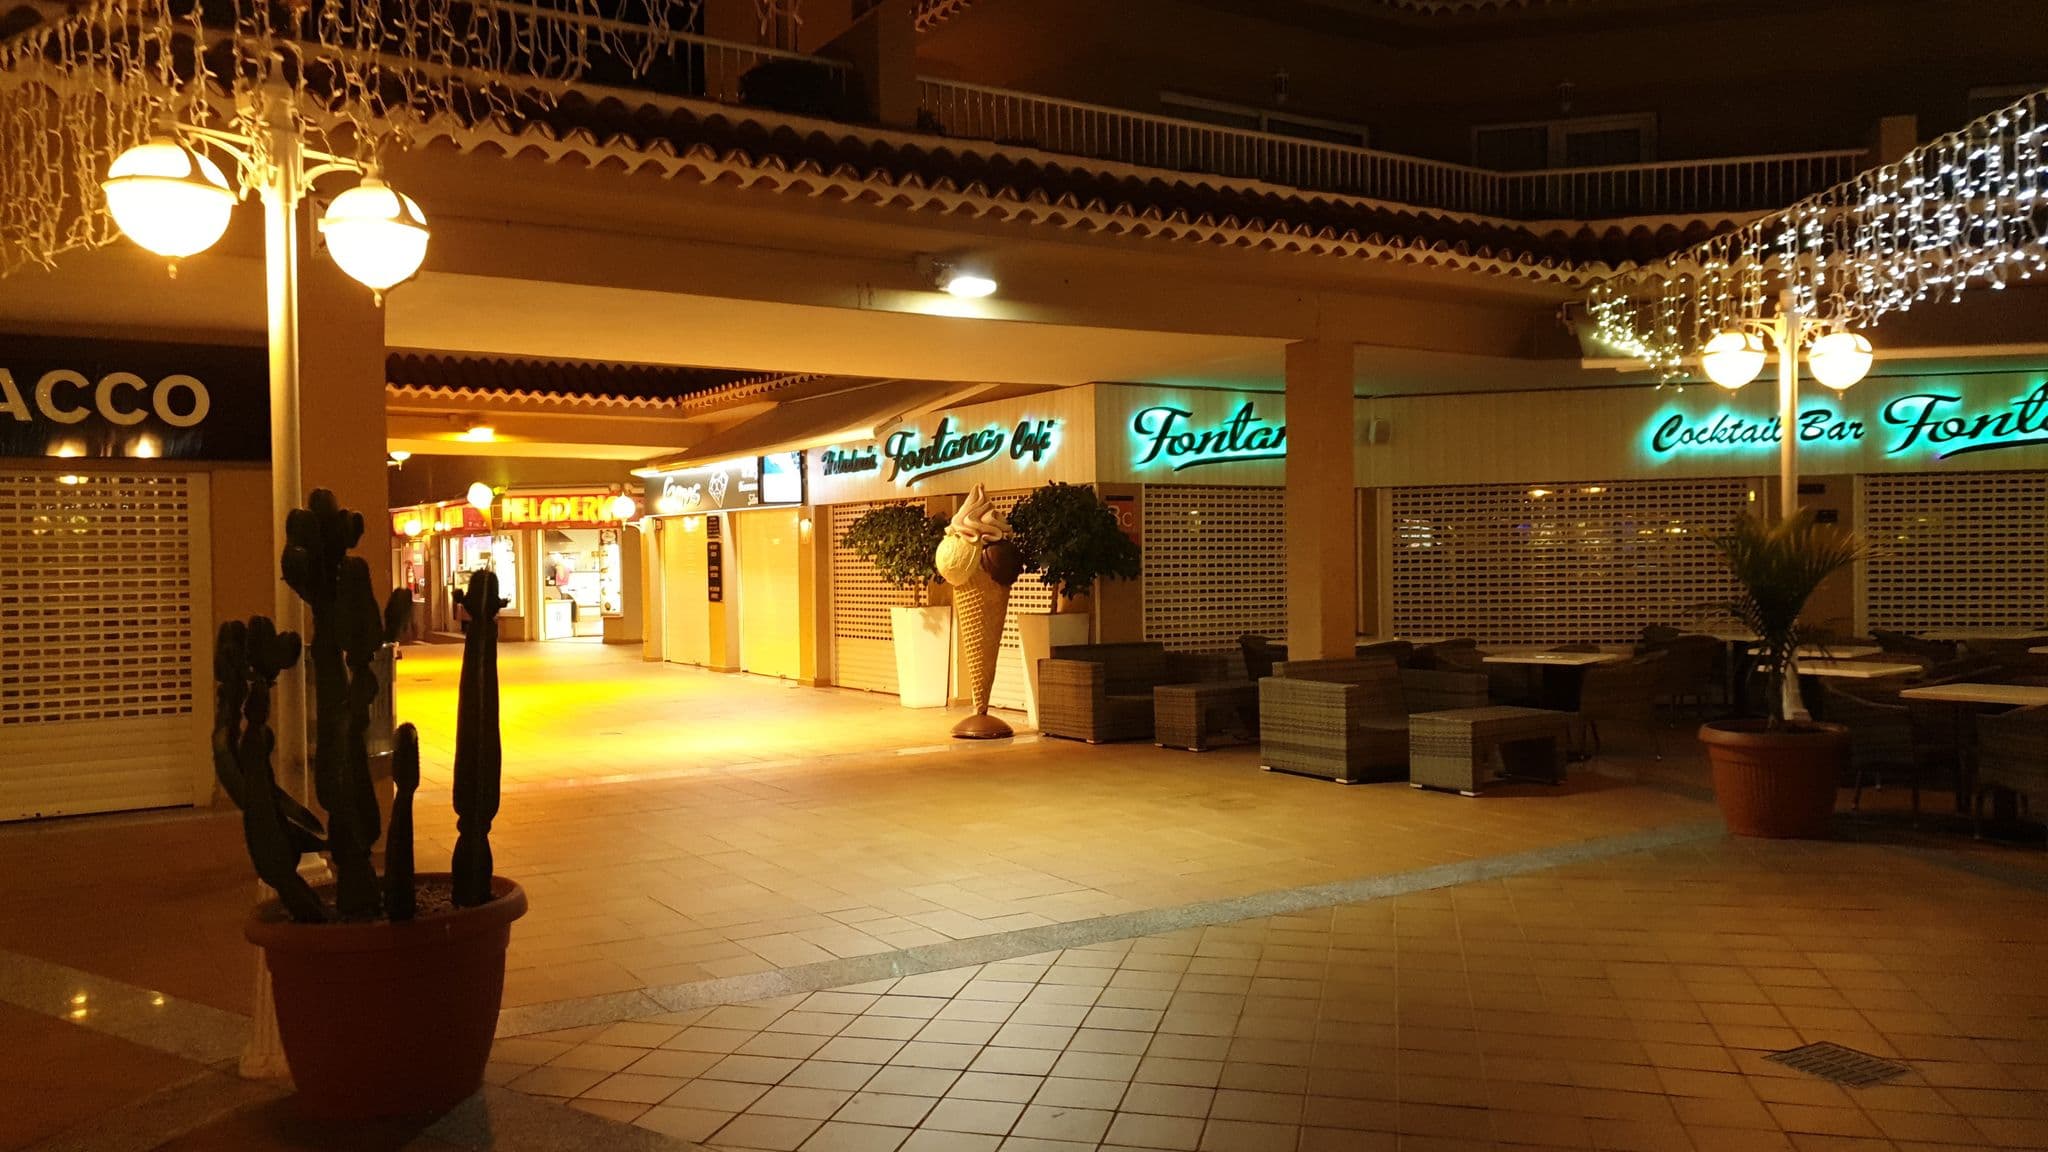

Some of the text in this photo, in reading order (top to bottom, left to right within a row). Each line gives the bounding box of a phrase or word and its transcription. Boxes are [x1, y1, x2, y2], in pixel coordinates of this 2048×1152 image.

[884, 417, 1004, 487] Fontana
[1009, 420, 1056, 461] Café
[1652, 409, 1865, 452] Cocktail Bar
[1883, 381, 2048, 460] Font
